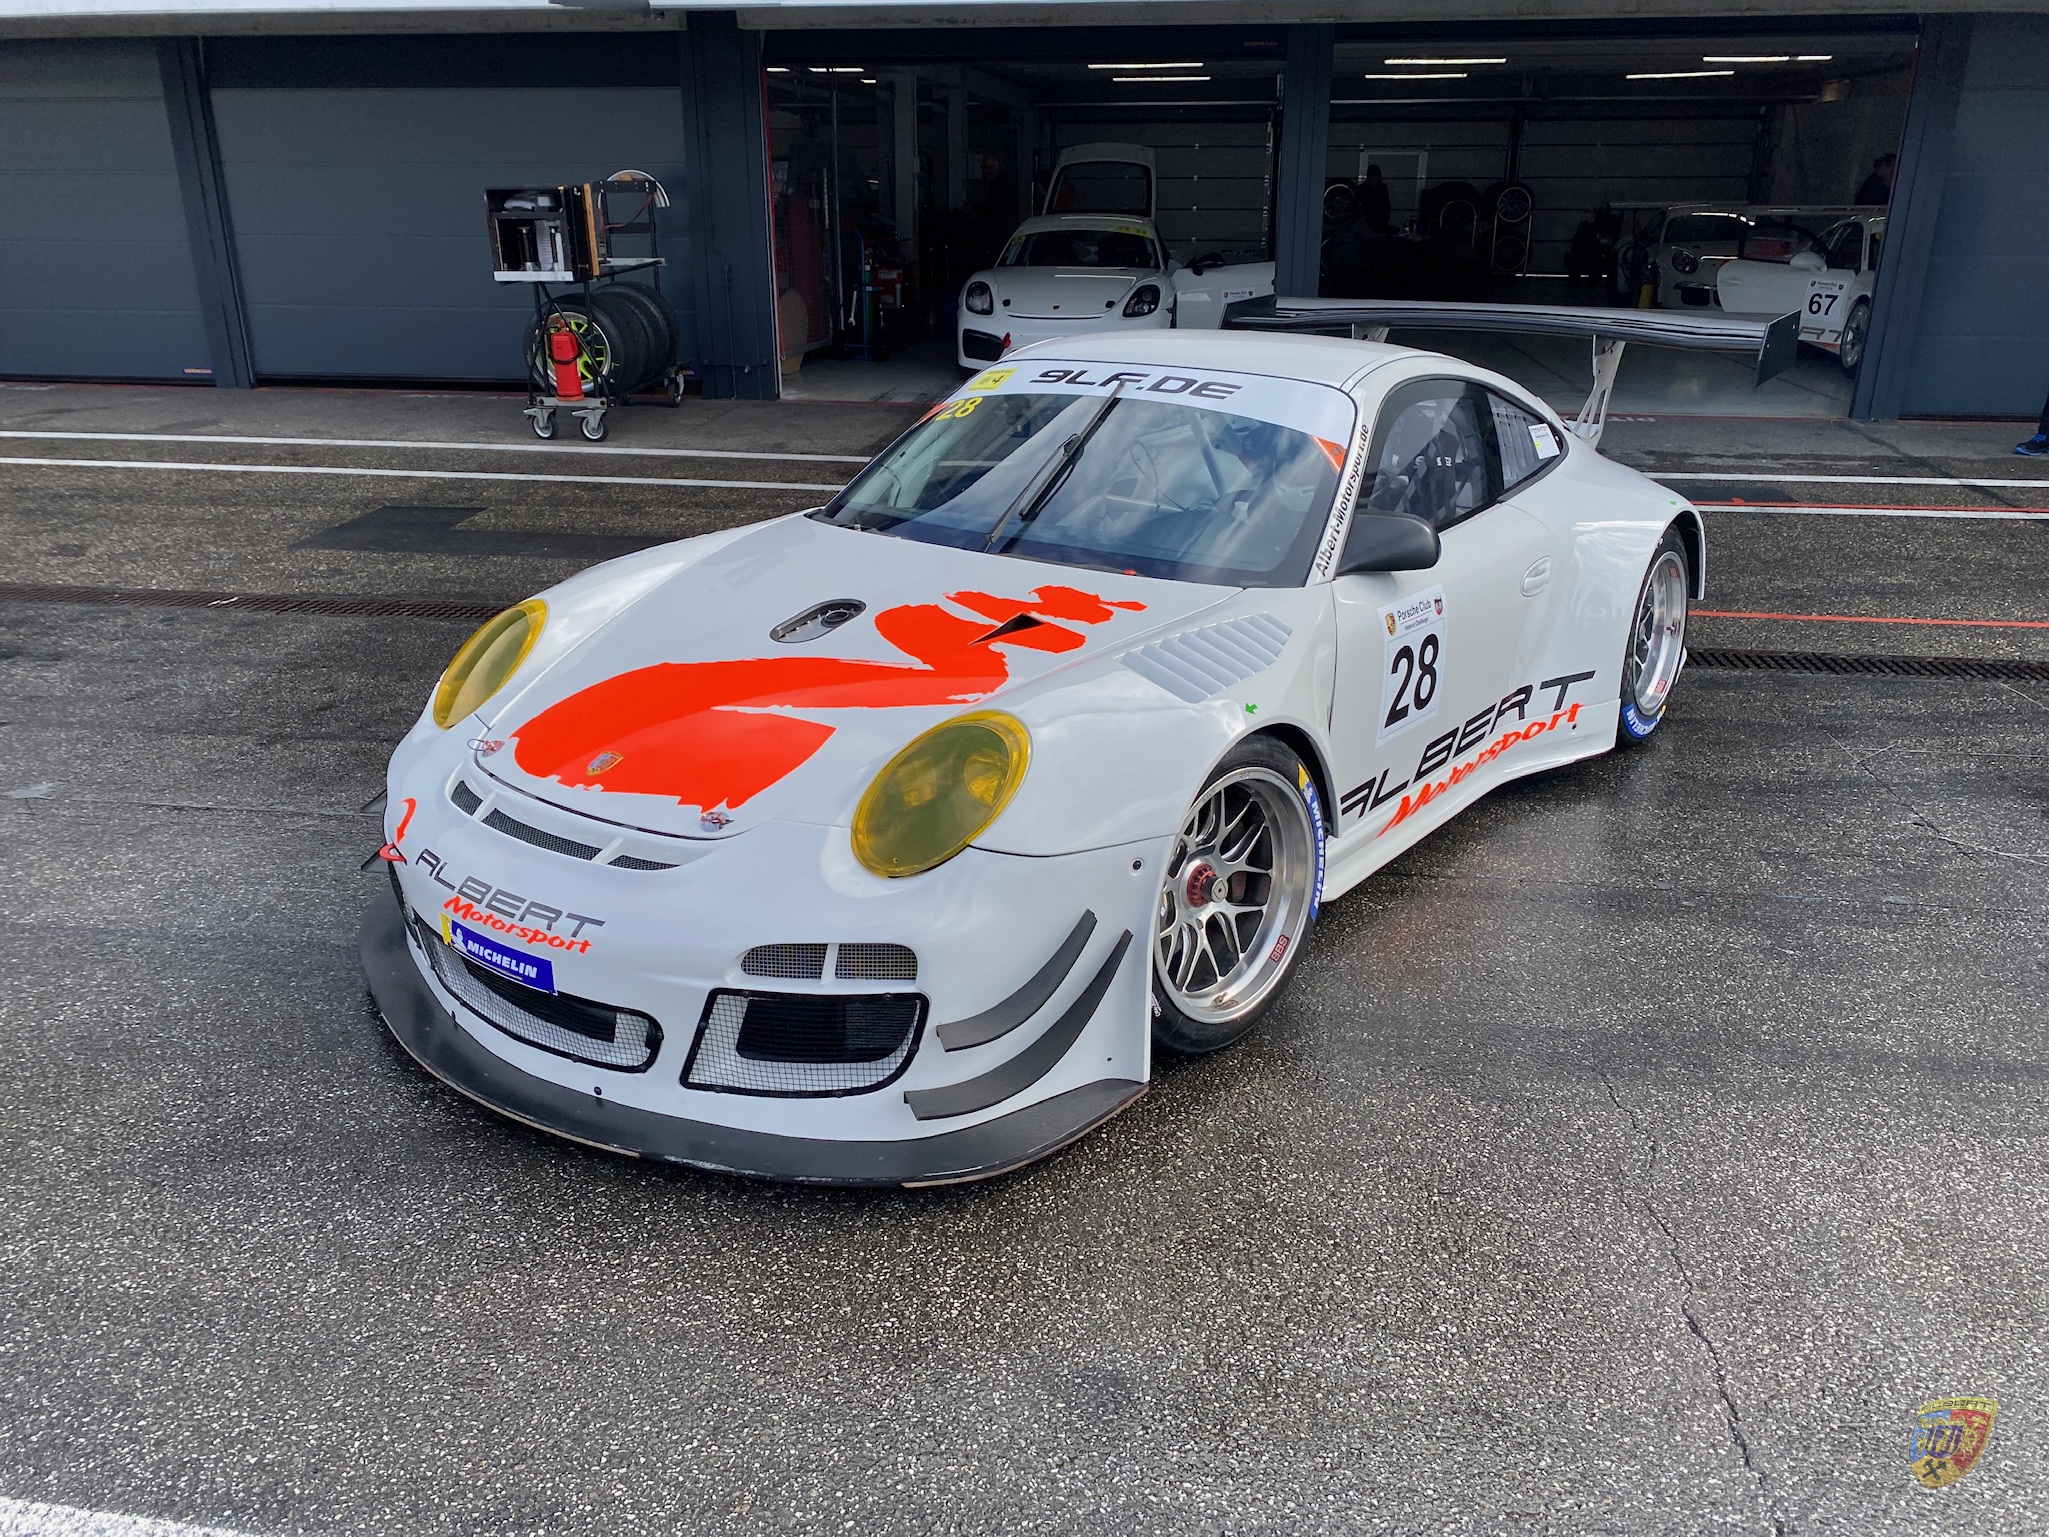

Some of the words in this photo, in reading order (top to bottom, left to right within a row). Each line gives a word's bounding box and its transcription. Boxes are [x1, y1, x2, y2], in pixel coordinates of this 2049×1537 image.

[1808, 292, 1839, 316] 67
[935, 396, 983, 421] 28
[1397, 605, 1419, 621] Porsche
[1419, 599, 1431, 611] Club
[1384, 633, 1440, 729] 28
[1340, 670, 1597, 818] ALBERT
[1375, 702, 1584, 839] Motorsport
[1310, 801, 1326, 910] MICHELIN
[415, 848, 606, 938] ALBERT
[443, 895, 595, 955] Motorsport
[1272, 935, 1288, 963] BBS
[466, 938, 538, 979] MICHELIN
